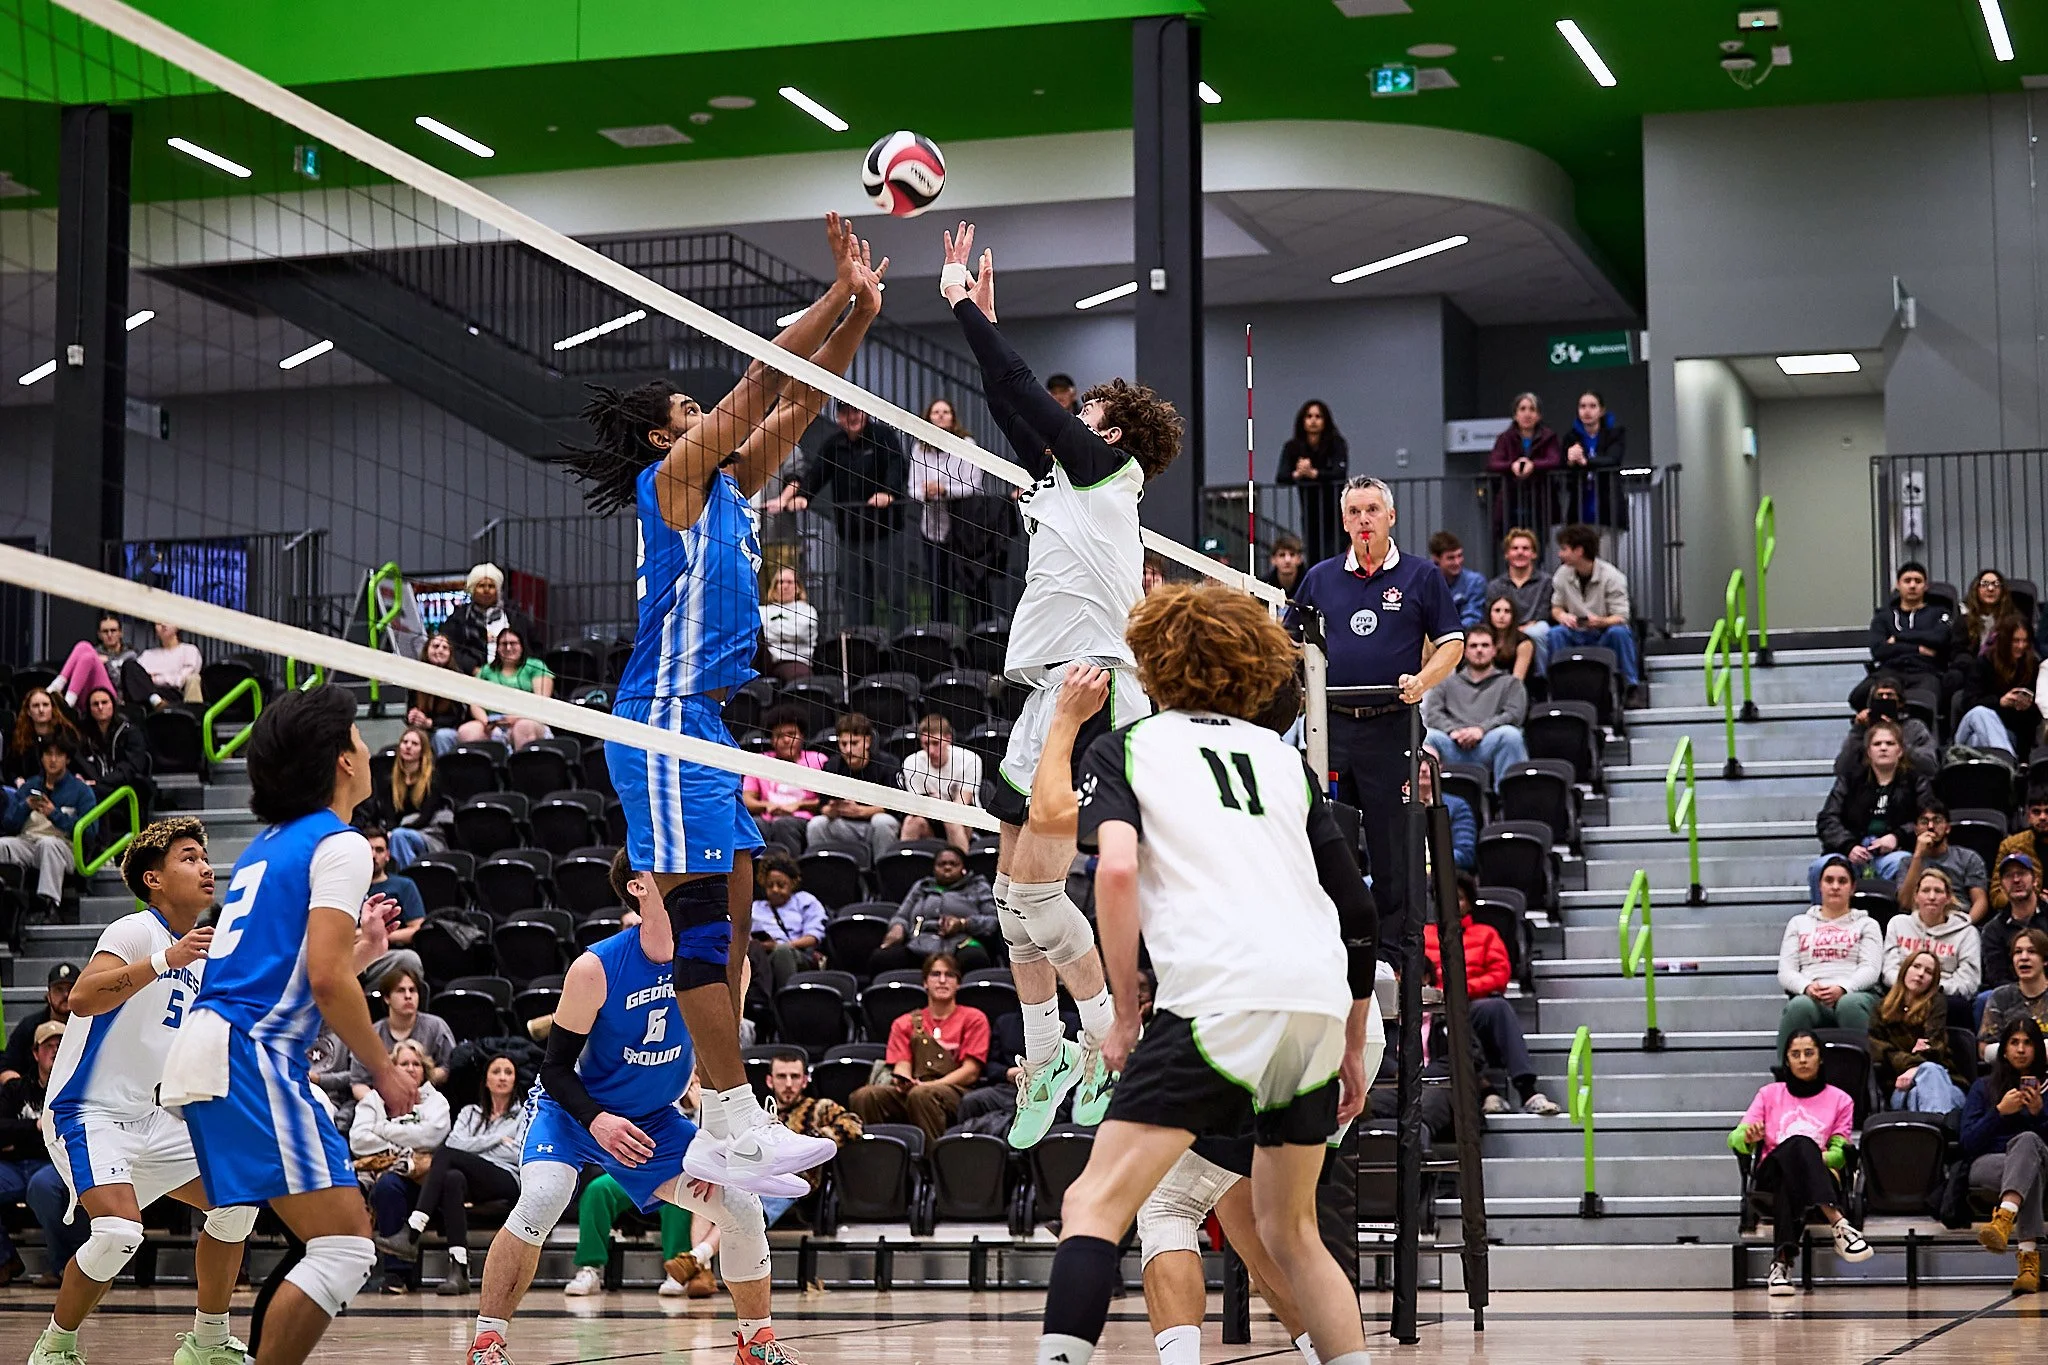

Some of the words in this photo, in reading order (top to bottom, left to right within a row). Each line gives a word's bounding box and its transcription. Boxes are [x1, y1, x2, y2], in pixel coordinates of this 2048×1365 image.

[1199, 746, 1265, 815] 11
[207, 860, 268, 959] 2
[161, 988, 185, 1029] 5
[642, 1006, 669, 1045] 6
[623, 1045, 682, 1066] BROWN
